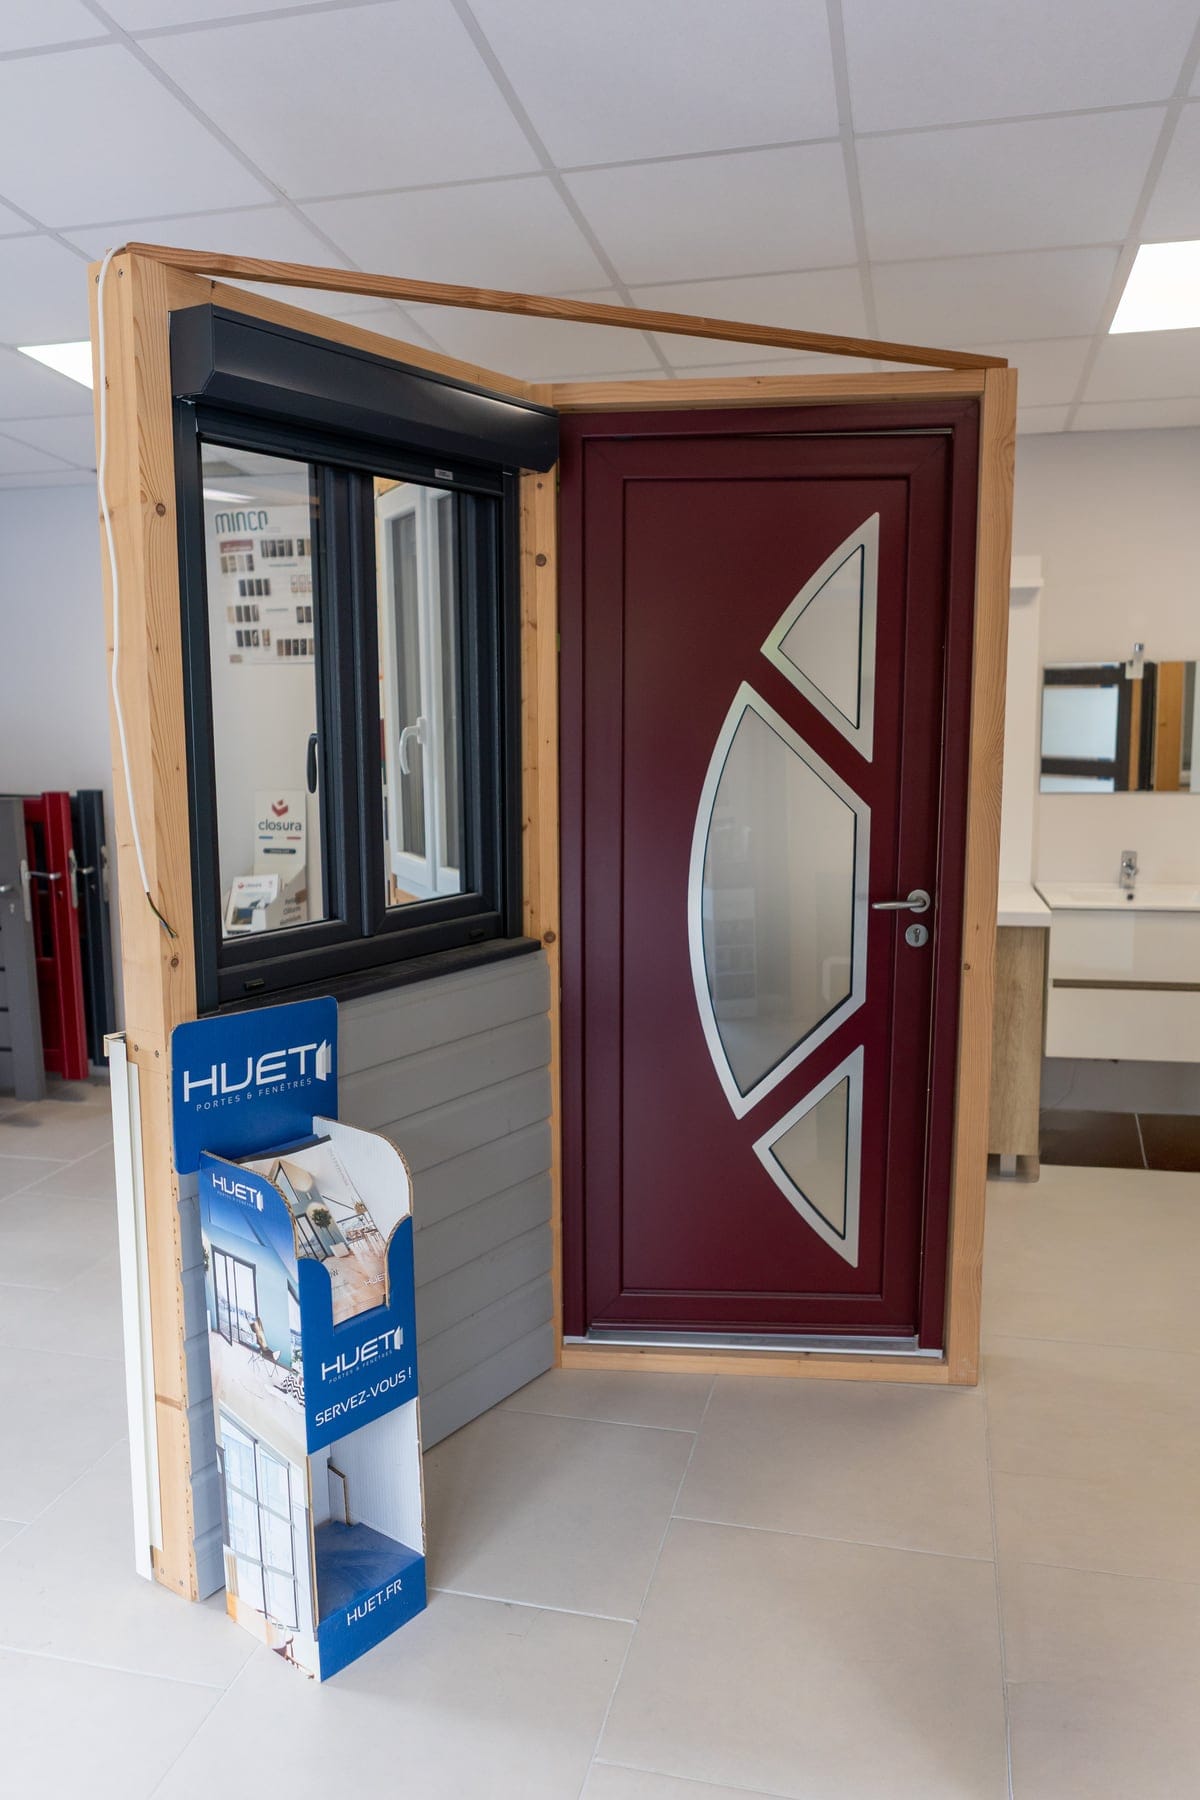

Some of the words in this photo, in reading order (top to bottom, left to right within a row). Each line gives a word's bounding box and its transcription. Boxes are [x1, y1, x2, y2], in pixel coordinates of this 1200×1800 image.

[258, 819, 302, 831] closura
[183, 1043, 317, 1103] HUET
[196, 1094, 241, 1112] PORTES
[246, 1092, 253, 1100] &
[258, 1077, 312, 1097] FENÊTRES
[212, 1173, 258, 1203] HUET
[363, 1272, 386, 1286] HUE
[321, 1329, 395, 1381] HUET
[346, 1578, 402, 1626] HUET.FR
